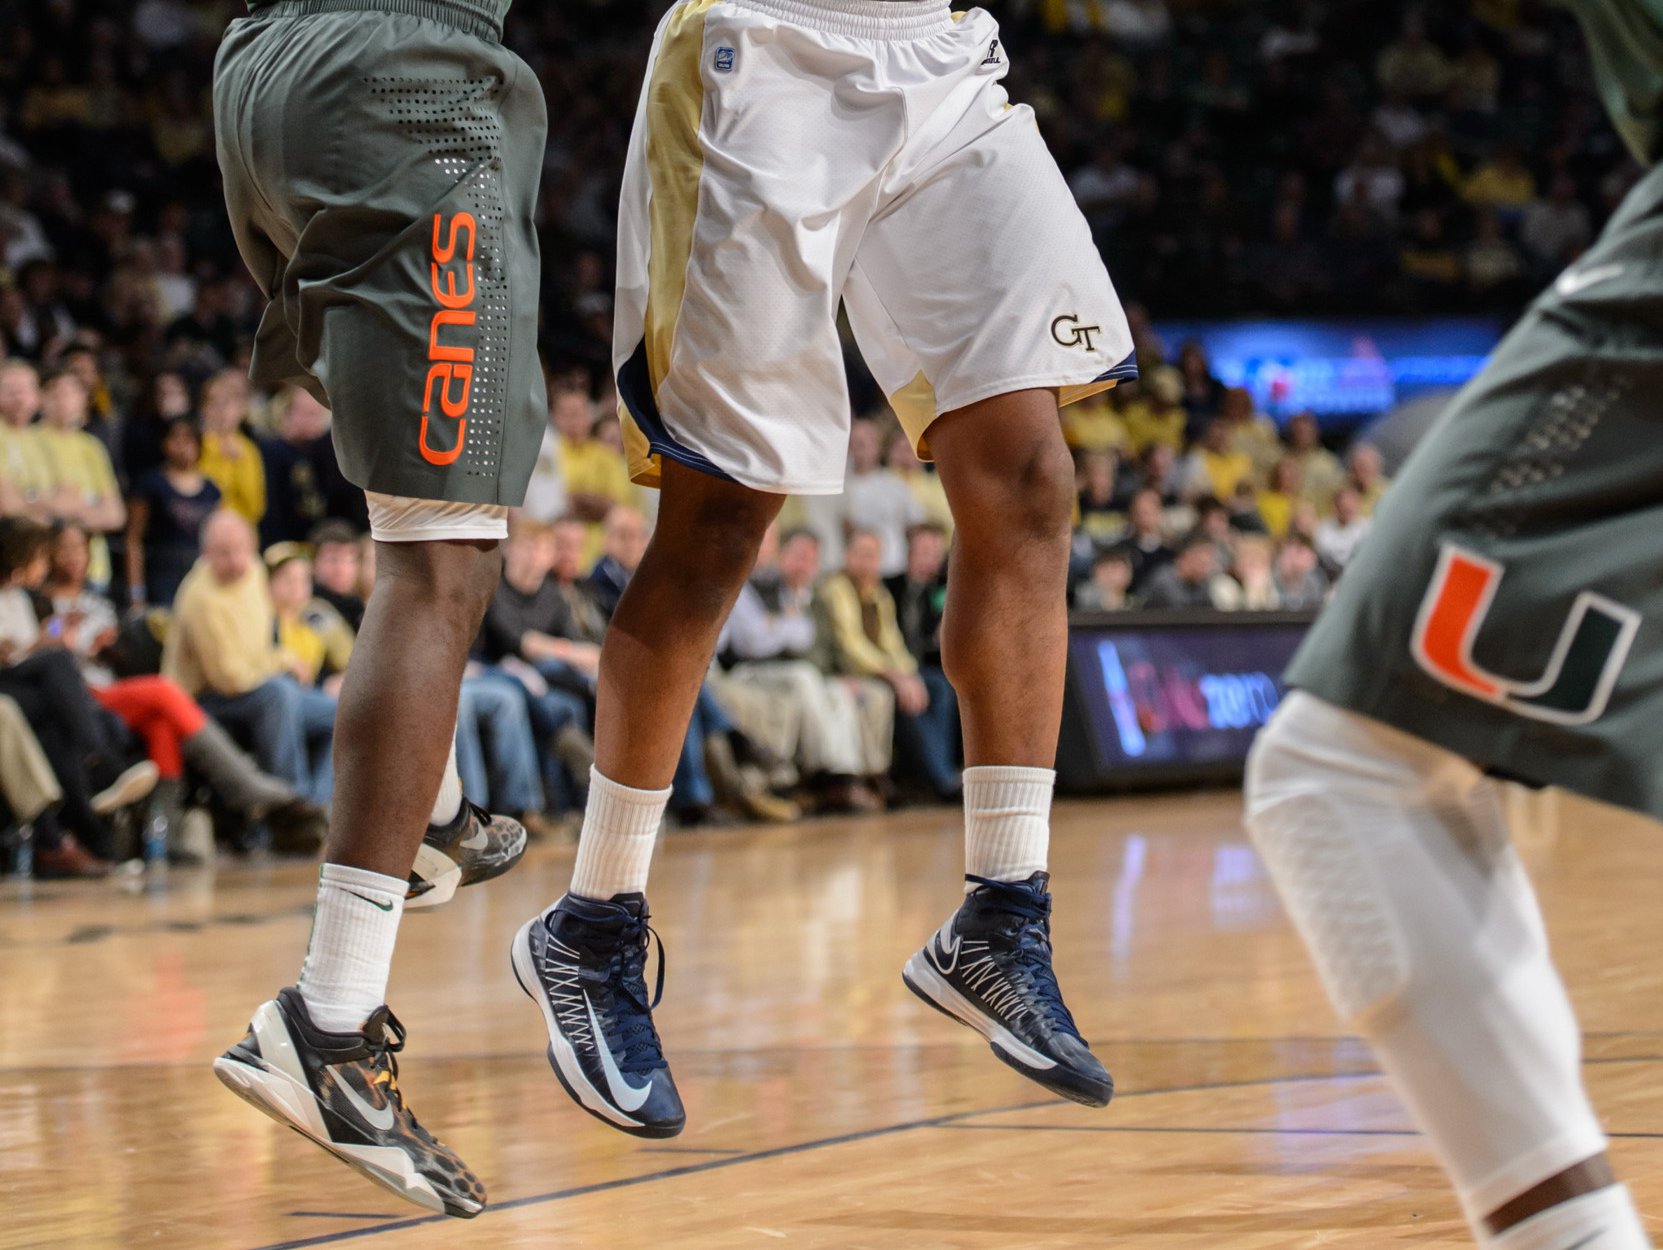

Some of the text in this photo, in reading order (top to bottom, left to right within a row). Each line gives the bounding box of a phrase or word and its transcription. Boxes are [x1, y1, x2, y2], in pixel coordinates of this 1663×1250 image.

[418, 212, 476, 466] canes
[1050, 312, 1102, 353] GT
[1409, 541, 1643, 726] U
